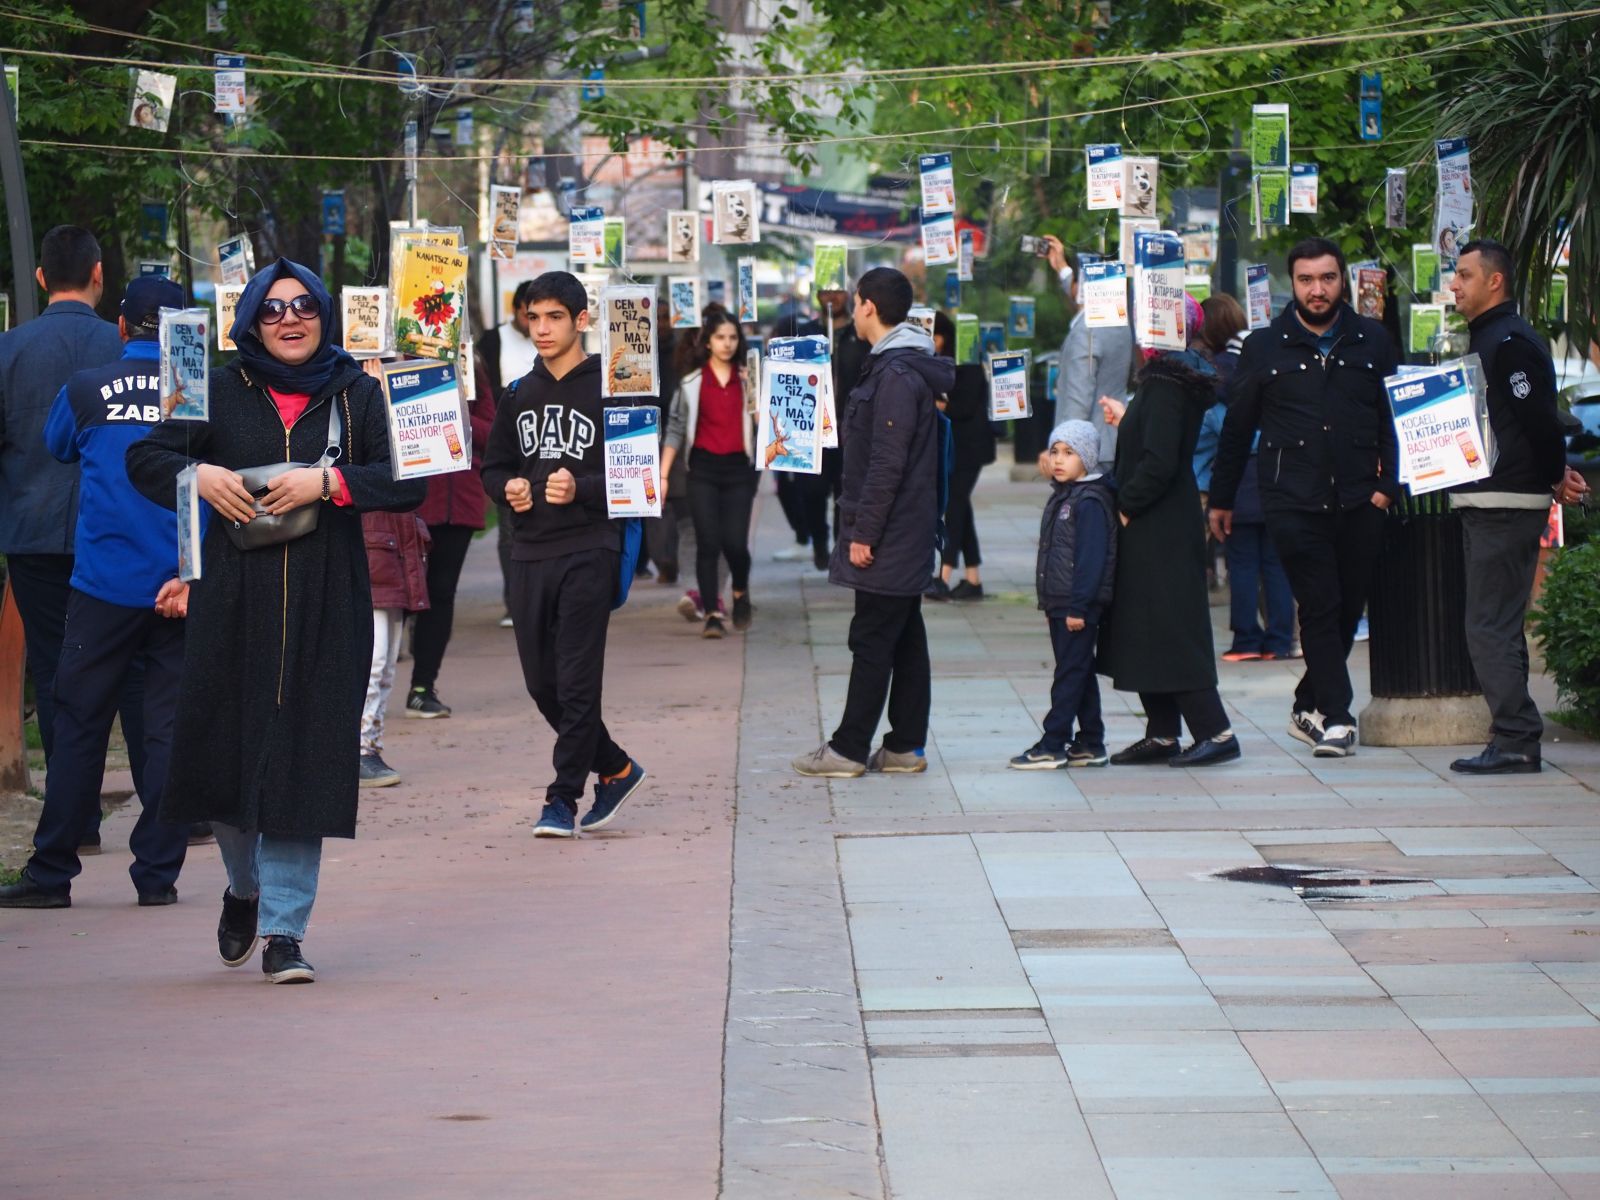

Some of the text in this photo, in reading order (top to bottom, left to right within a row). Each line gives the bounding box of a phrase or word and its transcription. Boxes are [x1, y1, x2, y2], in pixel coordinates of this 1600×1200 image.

[432, 266, 443, 274] MU
[615, 299, 634, 310] CEN
[176, 324, 191, 334] CEN
[610, 322, 628, 332] AYT
[625, 333, 641, 343] MA
[170, 346, 186, 356] AYT
[631, 343, 651, 354] TOV
[183, 358, 196, 368] MA
[189, 369, 204, 379] TOV
[778, 374, 799, 384] CEN
[100, 376, 159, 400] BÜYÜK
[770, 396, 791, 407] AYT
[107, 404, 160, 422] ZAB
[396, 403, 428, 417] KOCAELİ
[786, 408, 804, 419] MA
[433, 410, 456, 423] FUARI
[1401, 413, 1437, 429] KOCAELİ
[792, 420, 814, 431] TOV
[1444, 417, 1471, 432] FUARI
[517, 404, 595, 460] GAP
[609, 444, 632, 454] KOCAELİ
[635, 455, 654, 465] FUARI
